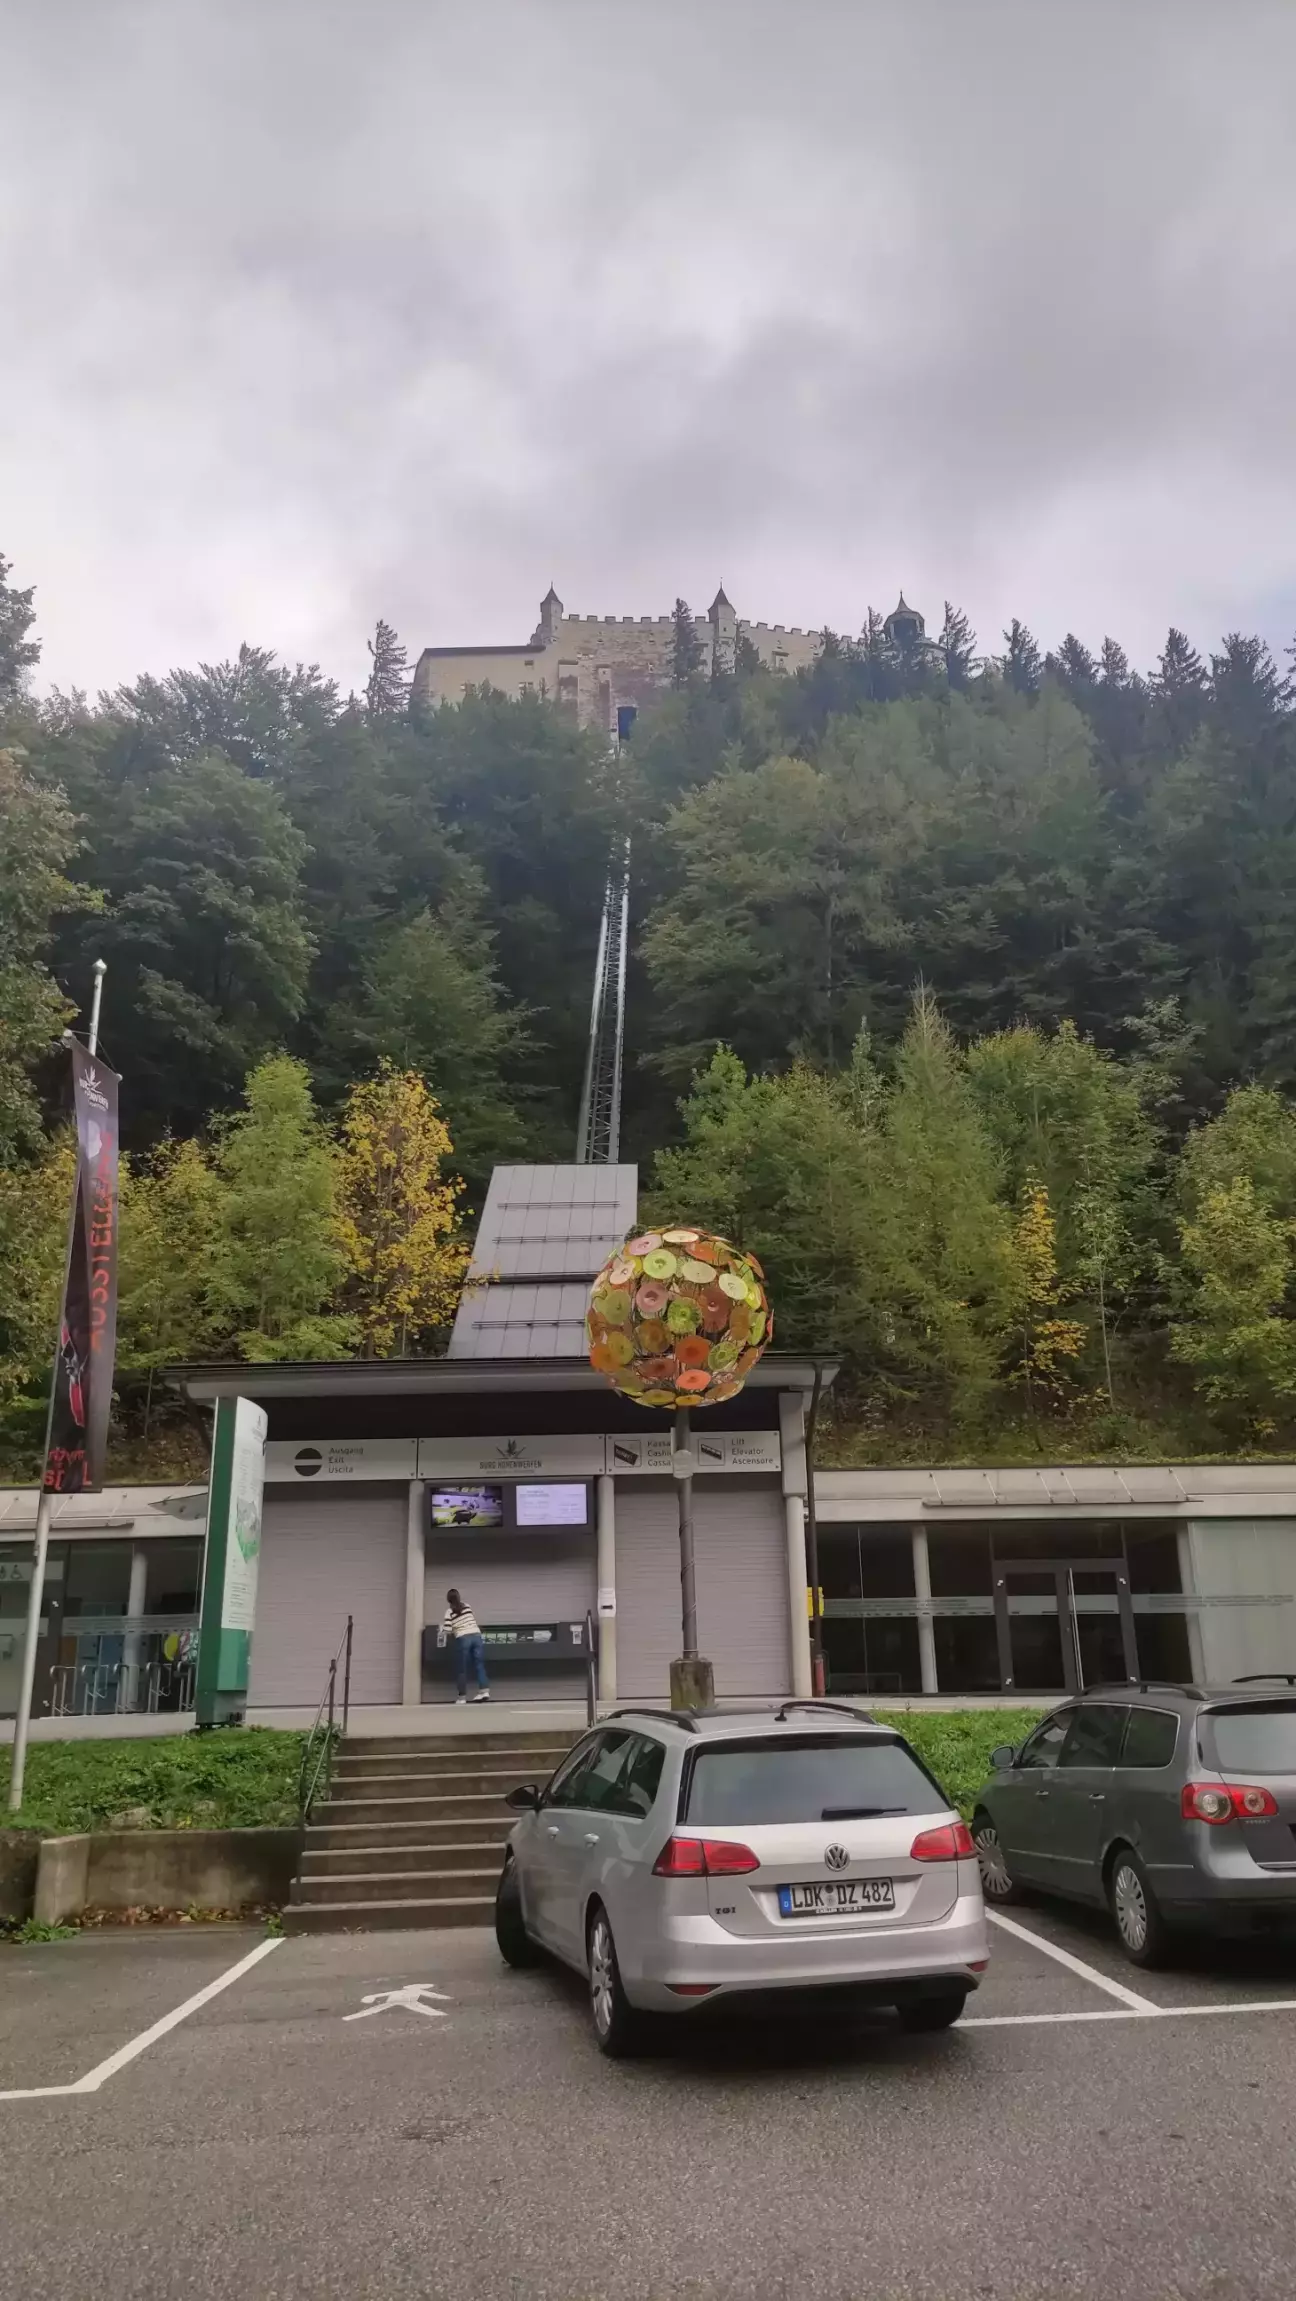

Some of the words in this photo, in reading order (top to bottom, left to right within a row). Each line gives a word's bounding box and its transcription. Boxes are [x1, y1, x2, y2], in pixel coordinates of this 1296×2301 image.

[731, 1438, 745, 1446] Lift
[328, 1447, 364, 1455] Ausgang
[731, 1447, 764, 1455] Elevator
[328, 1456, 345, 1464] Exit
[732, 1457, 774, 1465] Ascensore
[328, 1465, 354, 1473] Uscita
[791, 1886, 825, 1908] LDK
[836, 1883, 858, 1905] DZ
[861, 1881, 892, 1903] 482
